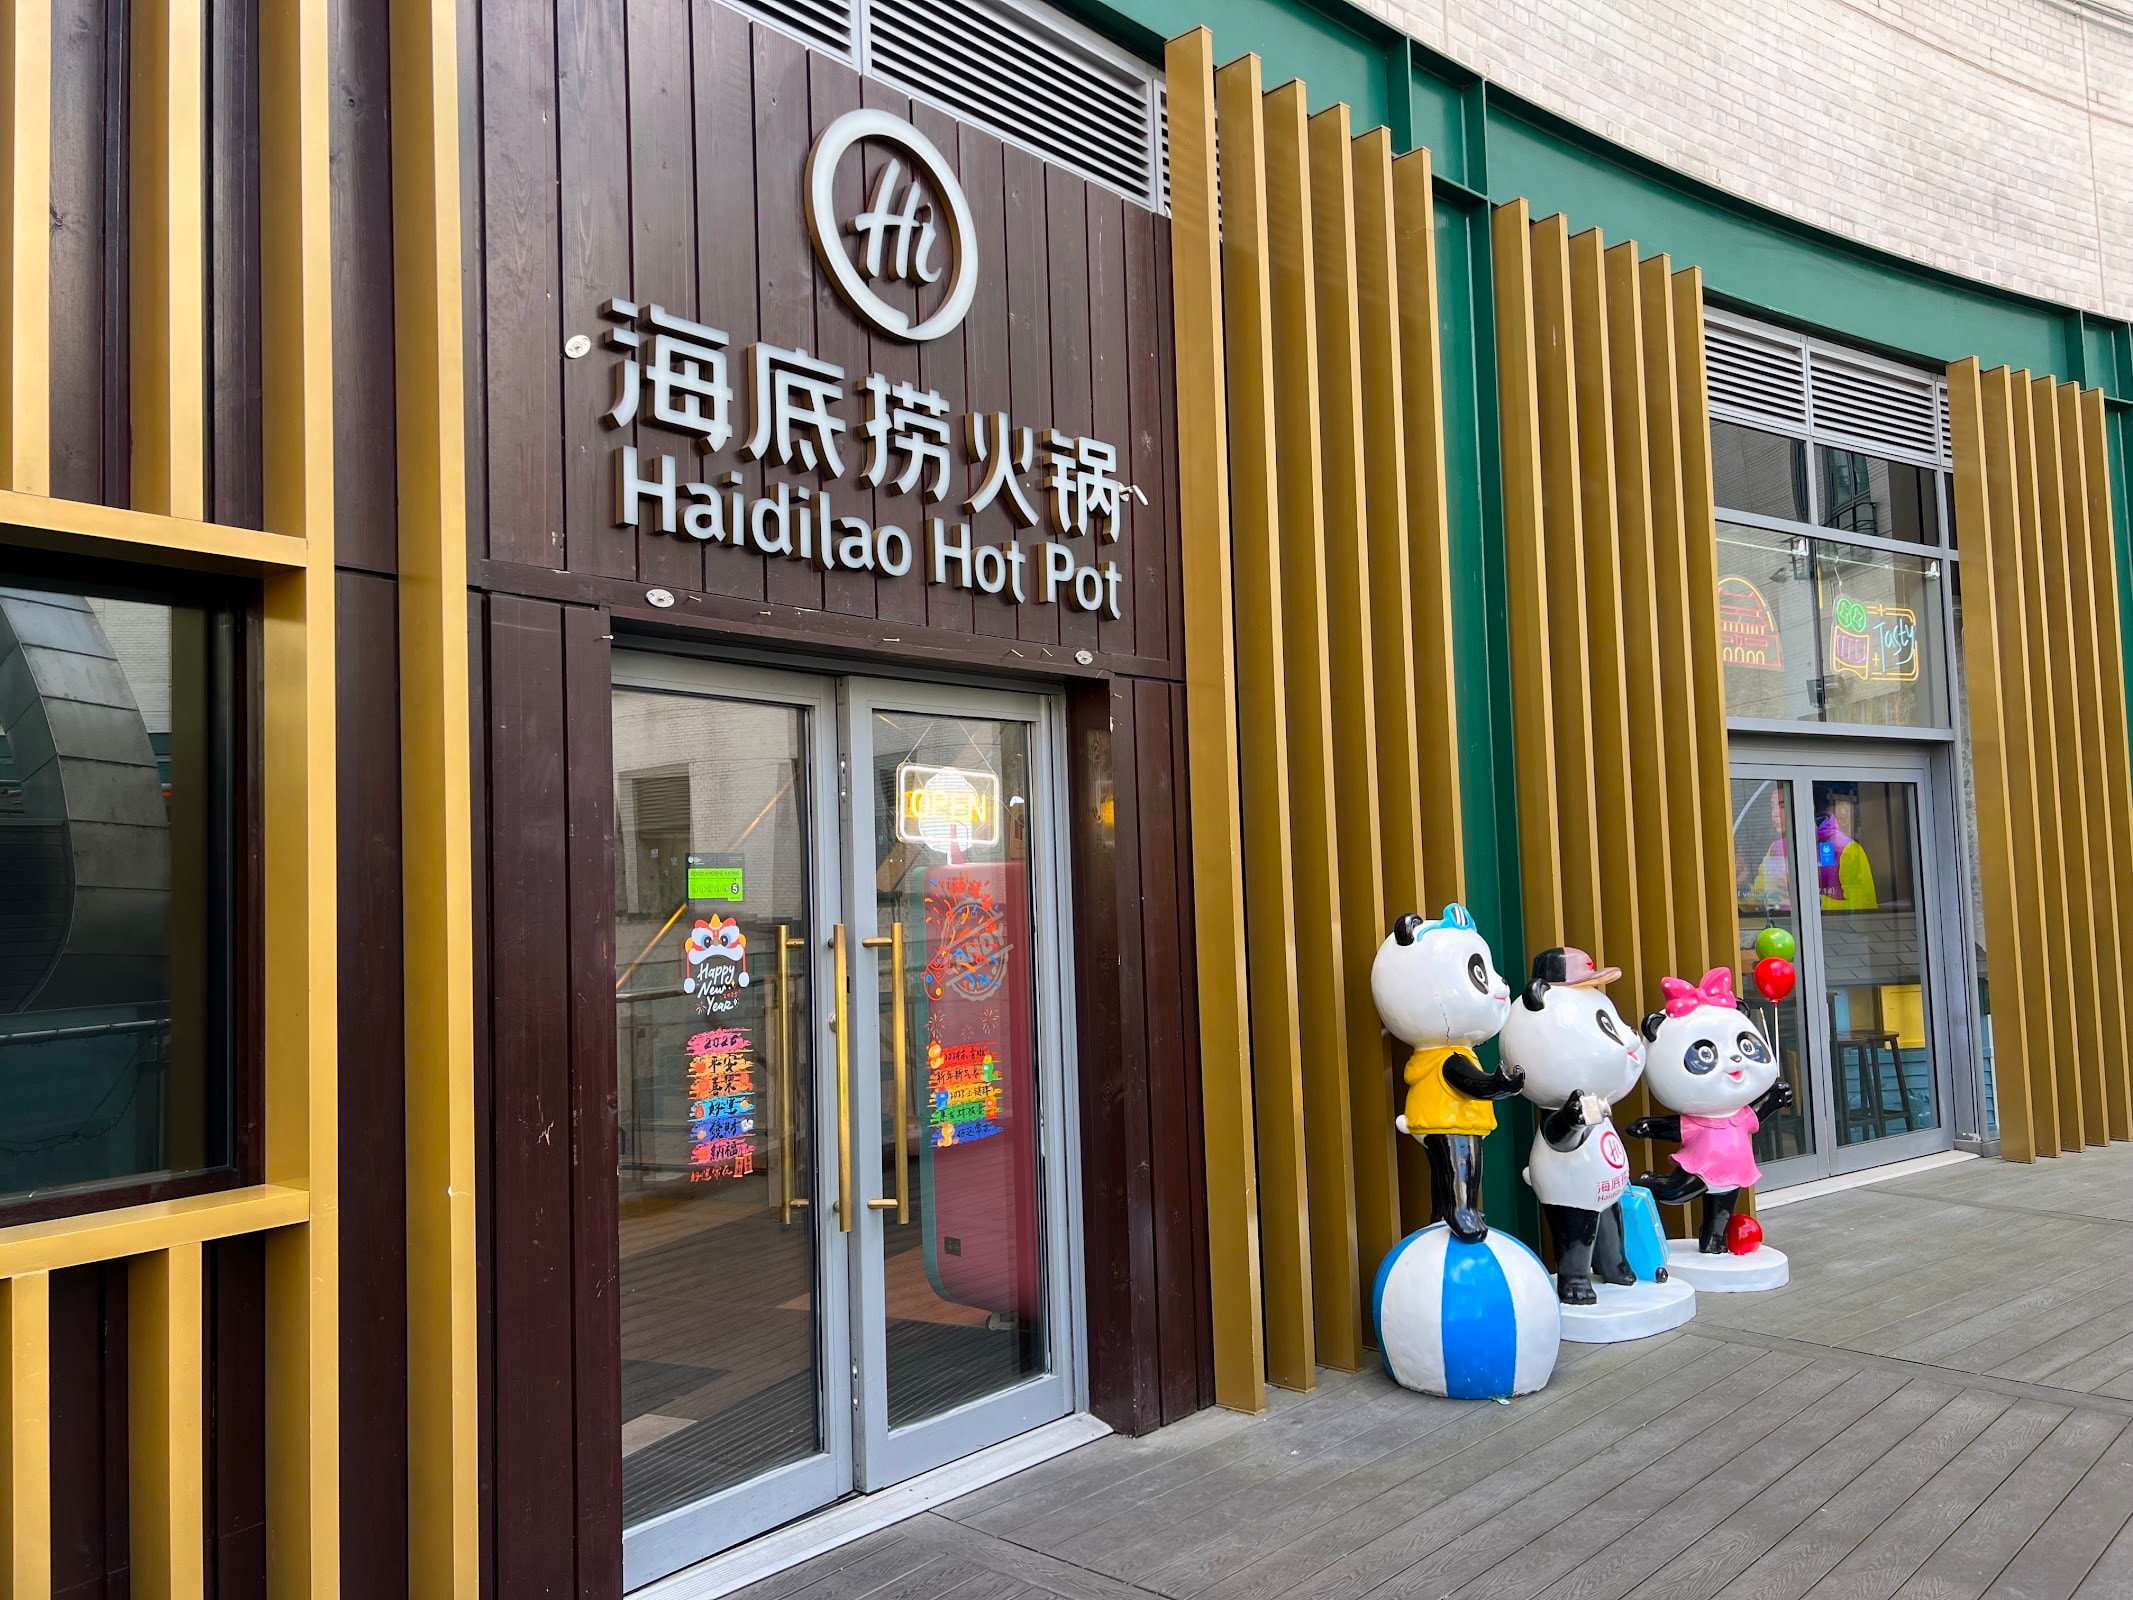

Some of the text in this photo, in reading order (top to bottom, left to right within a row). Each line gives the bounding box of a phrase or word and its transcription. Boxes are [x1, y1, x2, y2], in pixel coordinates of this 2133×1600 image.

[847, 157, 943, 285] Hi
[603, 298, 1122, 545] 海底捞火锅
[615, 445, 1122, 620] Haidilao Hot Pot
[1872, 618, 1915, 672] Tasty
[911, 788, 989, 824] OPEN
[697, 962, 736, 985] Happy
[697, 980, 727, 999] New
[708, 1053, 739, 1074] 平安
